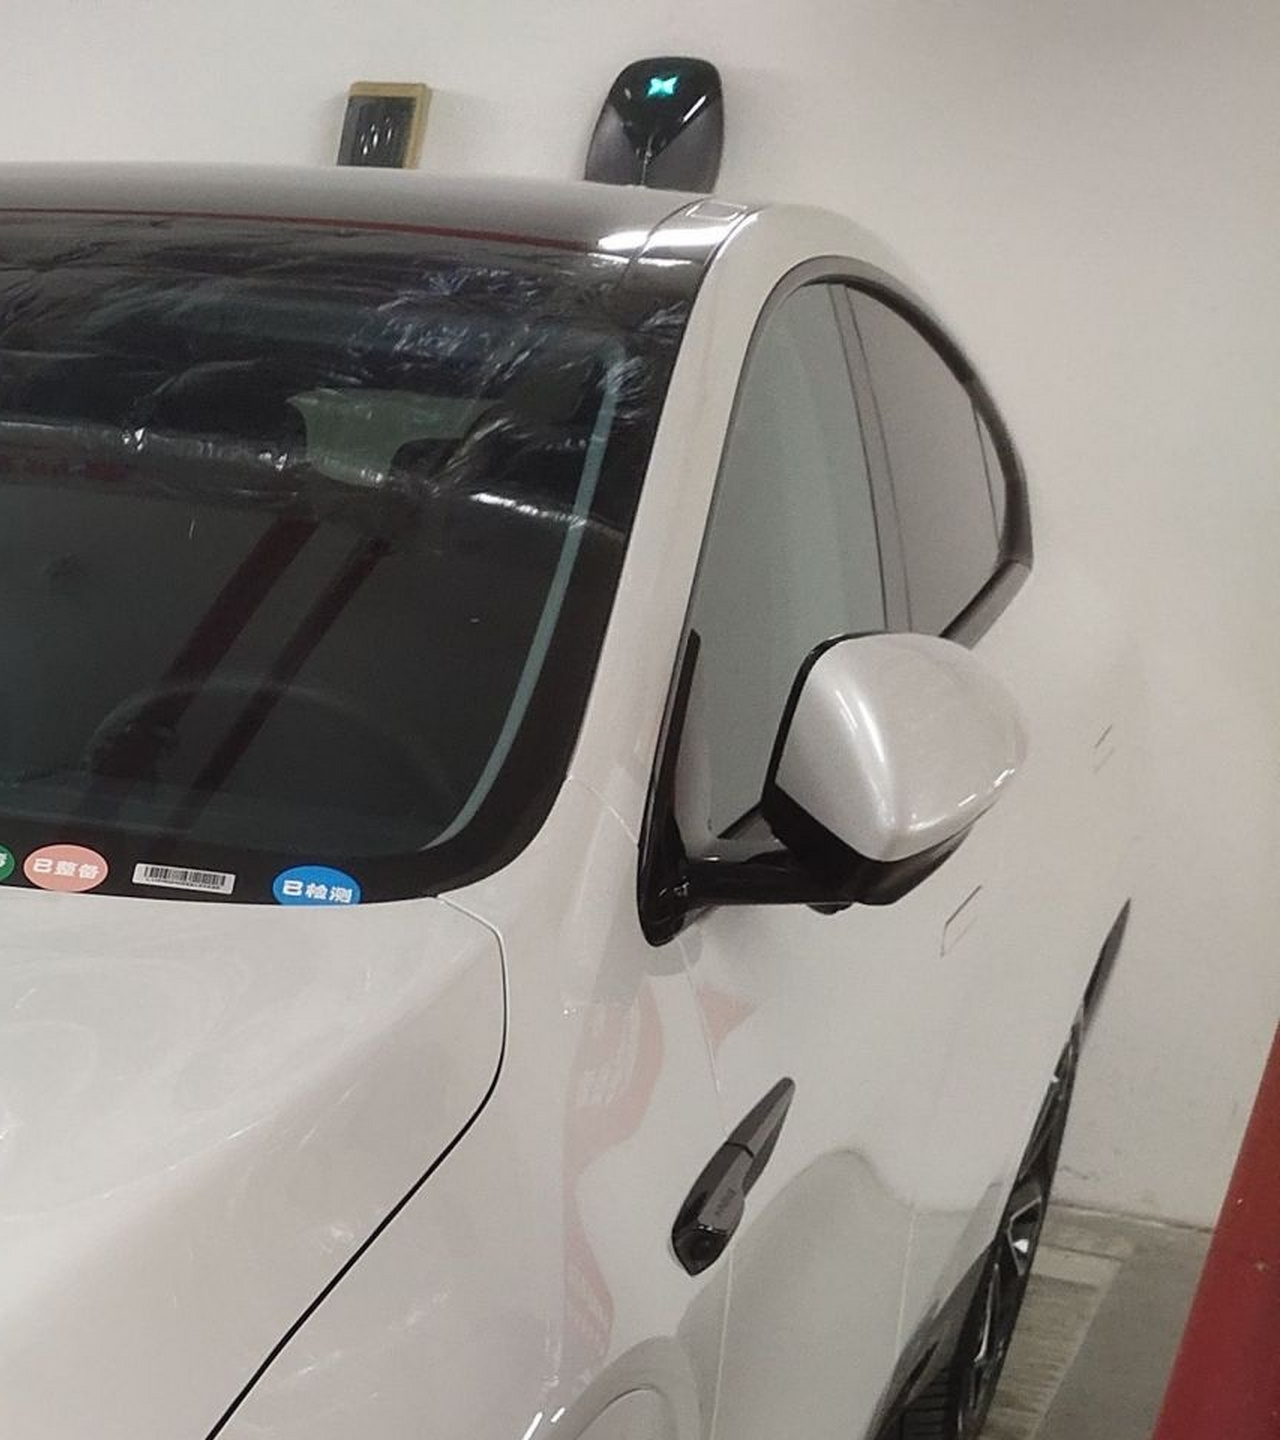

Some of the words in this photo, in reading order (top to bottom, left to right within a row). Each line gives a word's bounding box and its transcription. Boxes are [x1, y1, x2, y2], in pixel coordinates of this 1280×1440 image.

[32, 858, 100, 880] 已整备
[282, 879, 354, 904] 已检测
